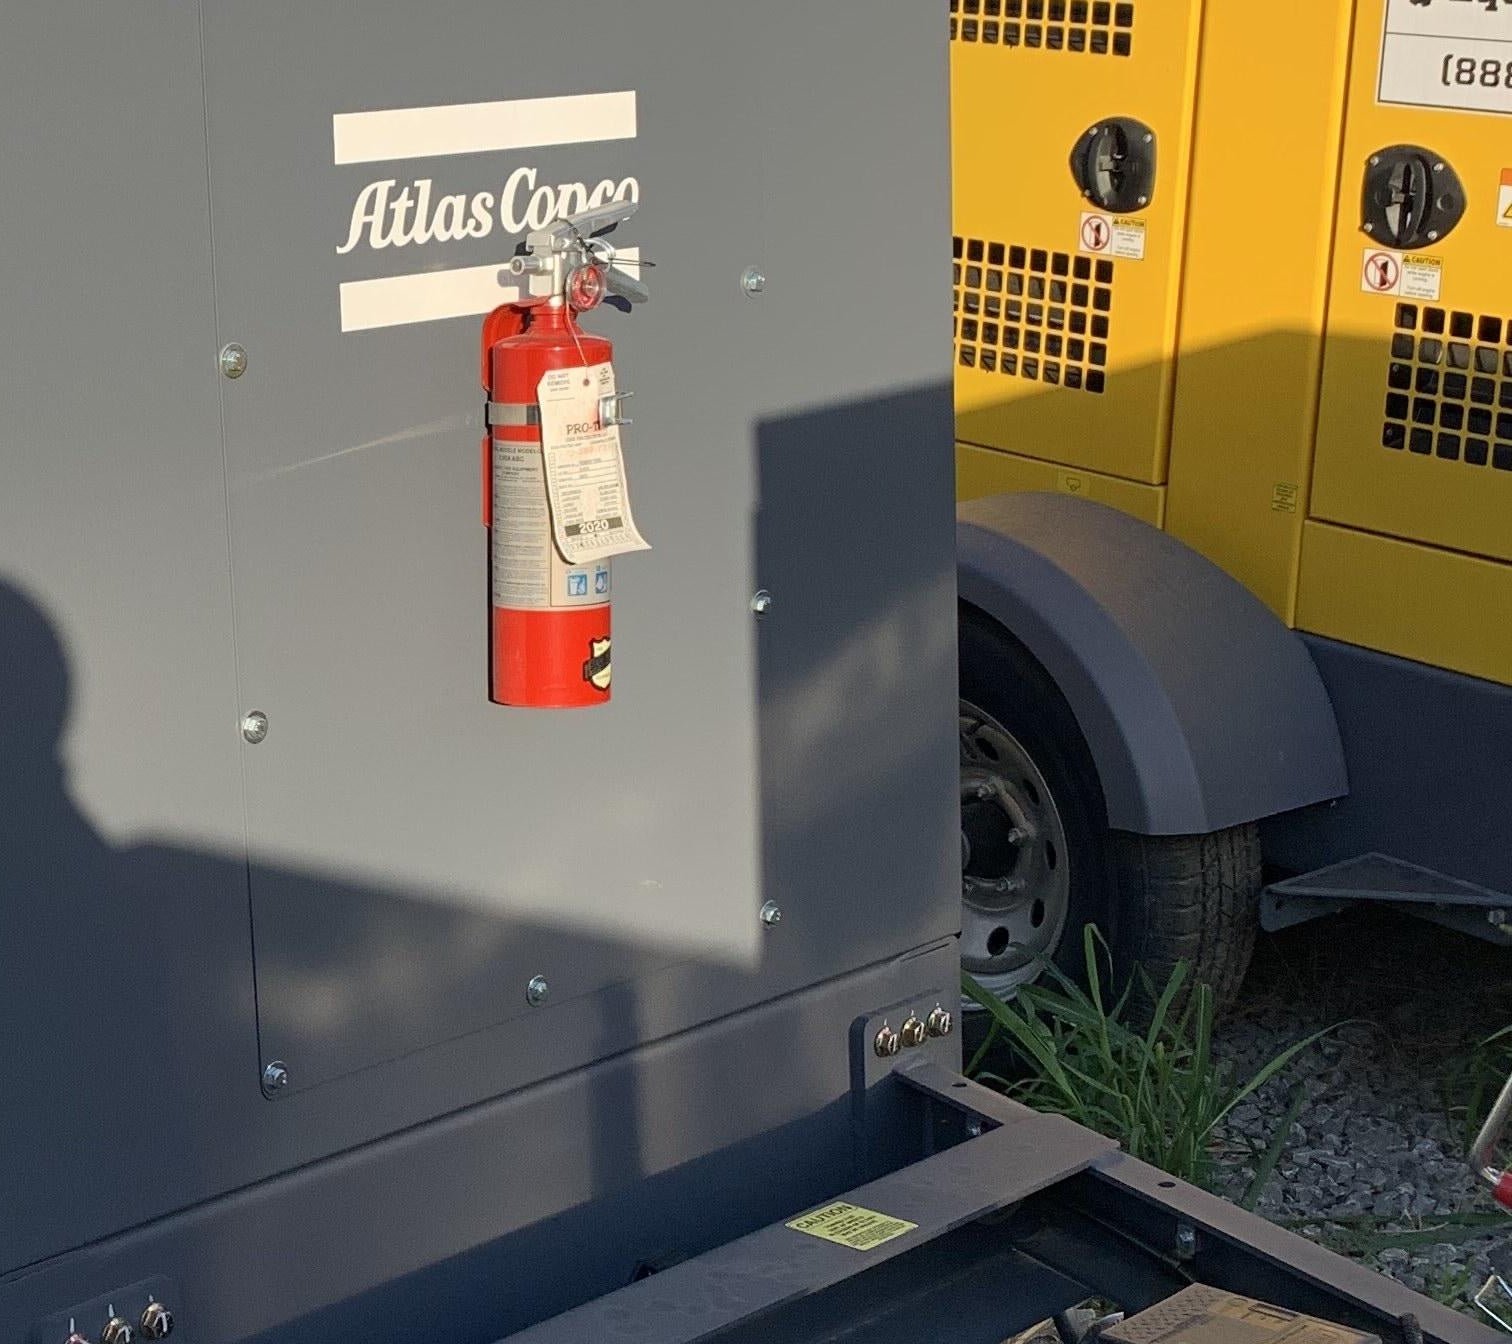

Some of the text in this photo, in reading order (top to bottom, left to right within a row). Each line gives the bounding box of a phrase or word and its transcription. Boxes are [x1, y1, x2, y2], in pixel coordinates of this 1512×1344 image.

[335, 178, 495, 255] Atlas
[1411, 255, 1441, 265] CAUTION
[579, 520, 609, 534] 2020
[796, 1204, 852, 1229] CAUTION
